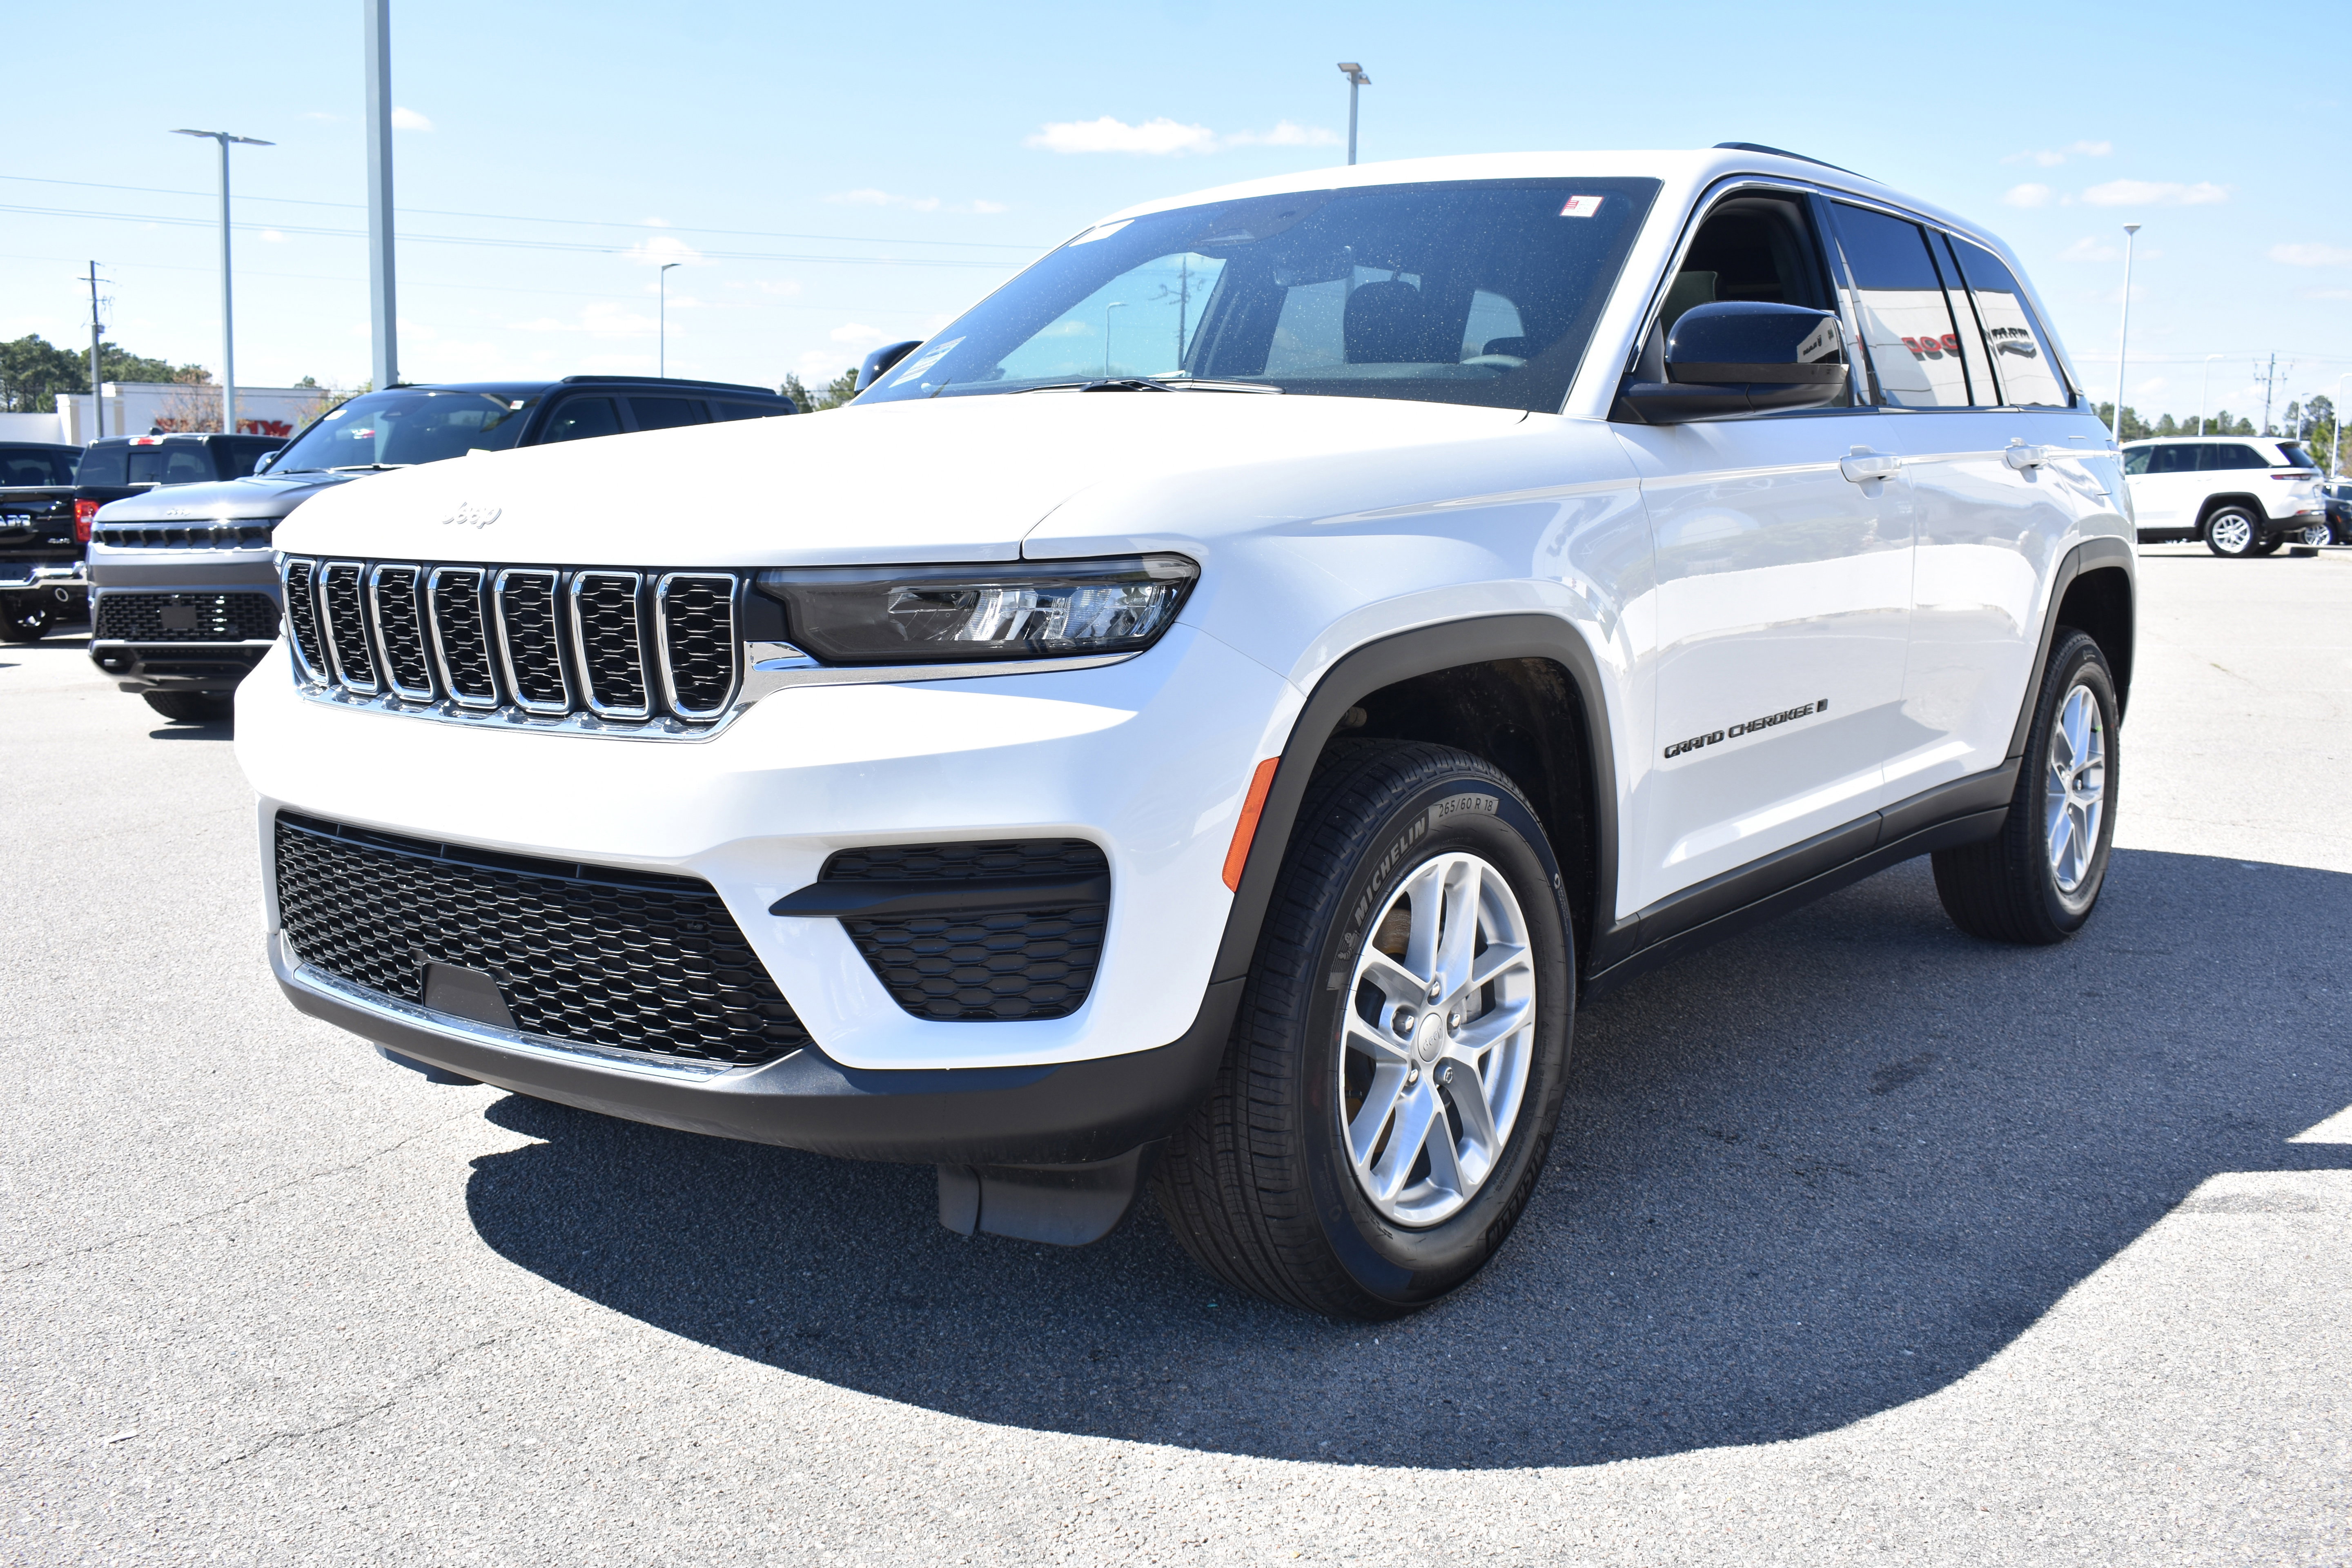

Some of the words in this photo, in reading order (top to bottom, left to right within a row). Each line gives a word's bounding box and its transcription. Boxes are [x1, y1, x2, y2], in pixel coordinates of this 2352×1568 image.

[441, 501, 503, 530] Jeep
[1664, 730, 1725, 759] GRAND
[1728, 703, 1815, 738] CHEROKEE
[1439, 797, 1472, 818] 265/60
[1474, 797, 1481, 810] R
[1484, 799, 1493, 812] 18
[1354, 817, 1425, 927] MICHELIN
[1488, 1138, 1546, 1246] MICHELIN
